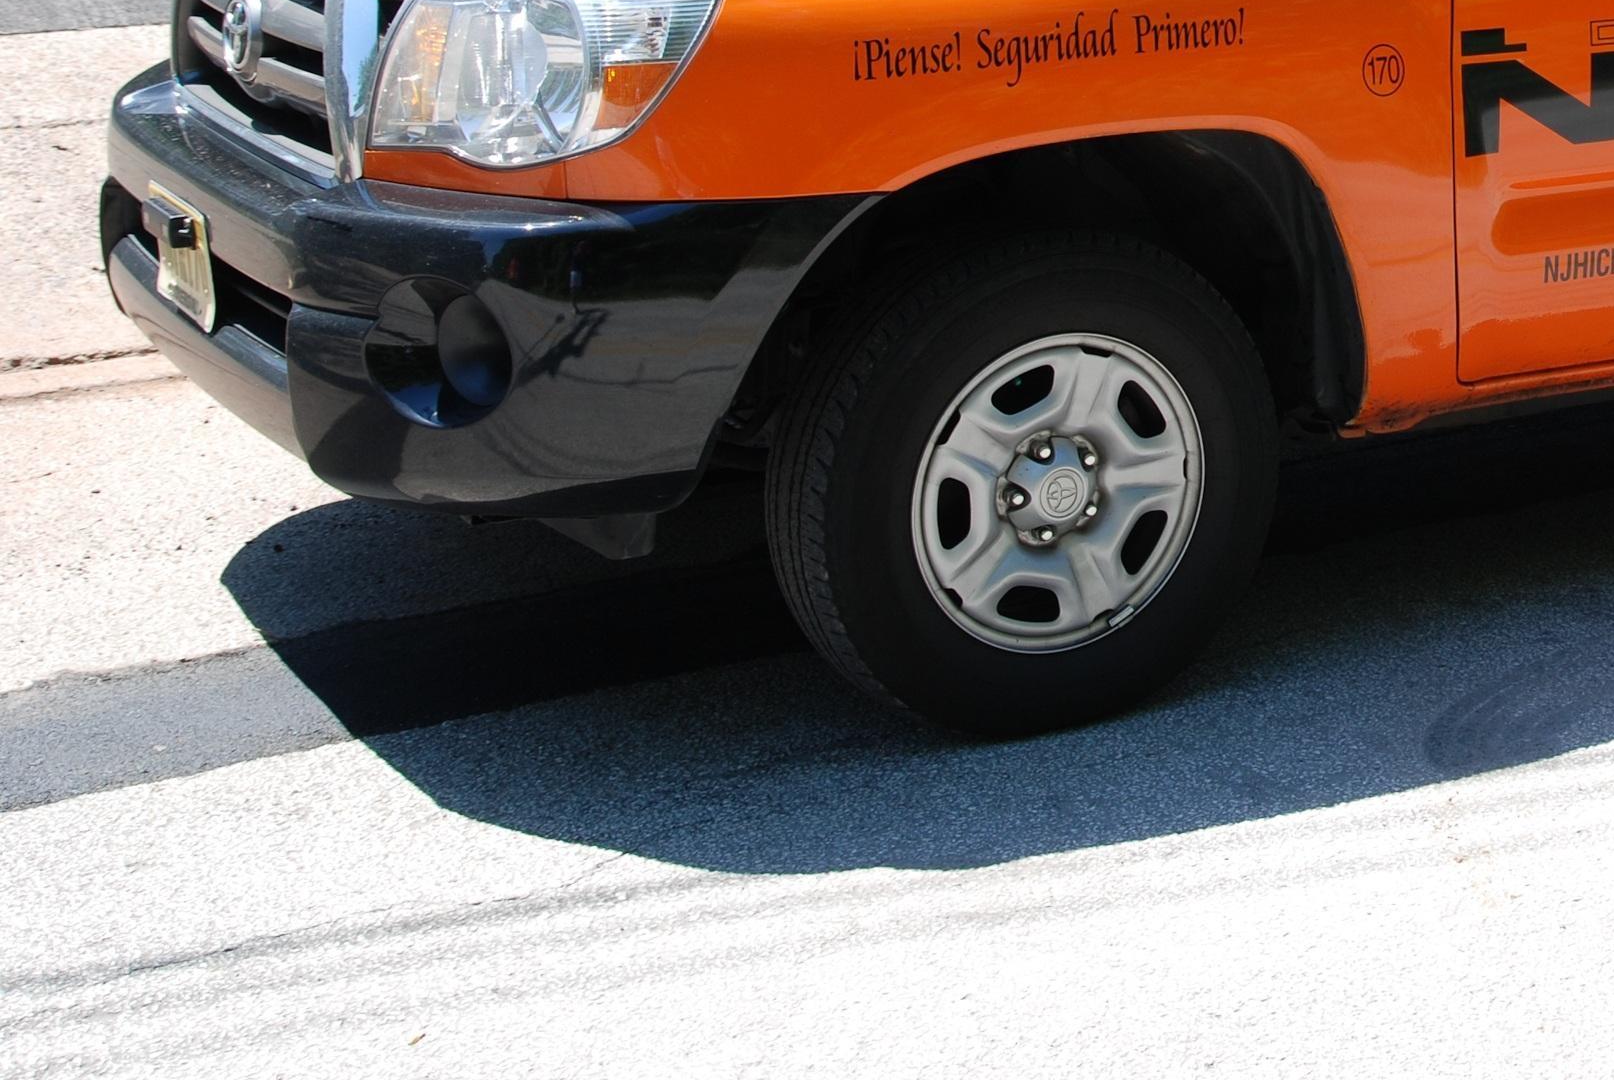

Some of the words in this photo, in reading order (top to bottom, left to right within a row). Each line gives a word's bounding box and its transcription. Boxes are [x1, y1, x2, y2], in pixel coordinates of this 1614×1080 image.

[853, 31, 963, 81] ¡Piense!
[975, 8, 1119, 87] Seguridad
[1131, 7, 1245, 54] Primero!
[1368, 55, 1400, 85] 170
